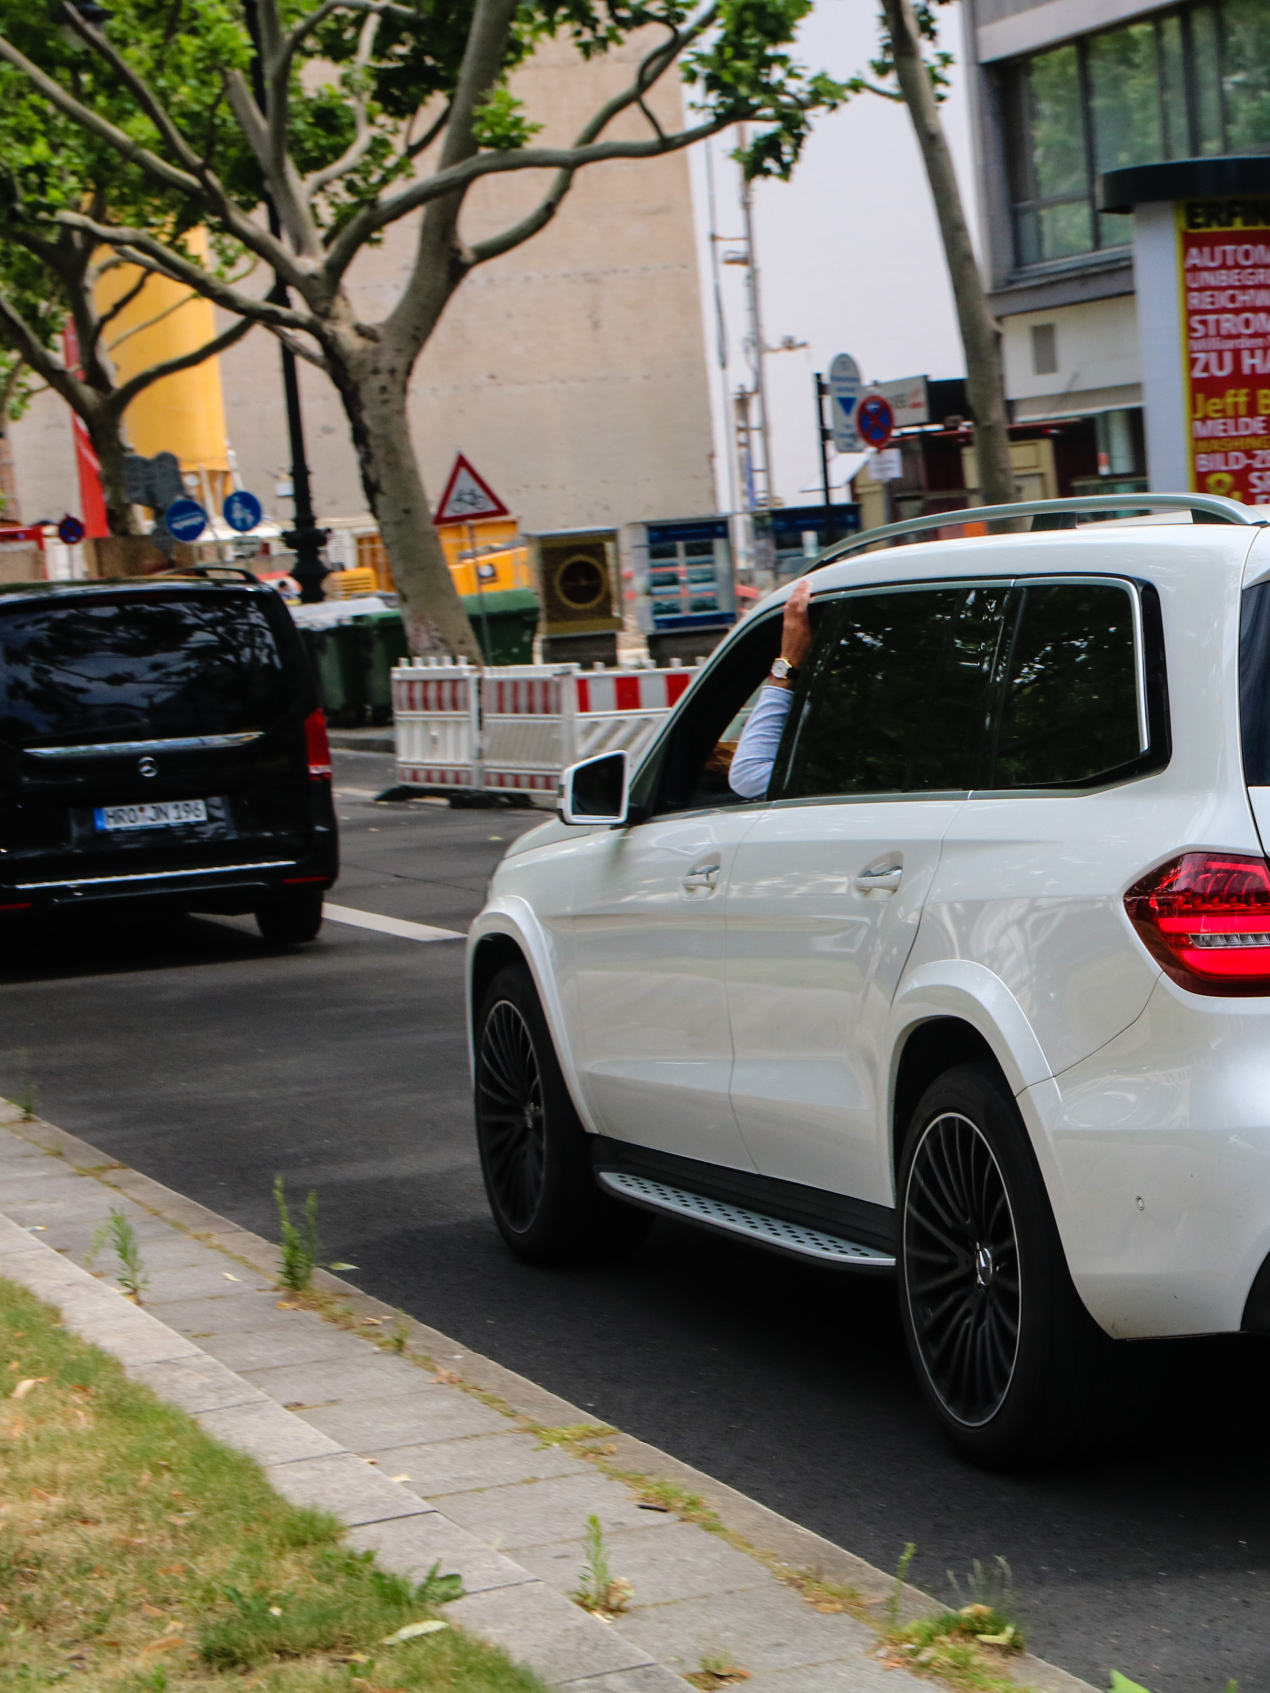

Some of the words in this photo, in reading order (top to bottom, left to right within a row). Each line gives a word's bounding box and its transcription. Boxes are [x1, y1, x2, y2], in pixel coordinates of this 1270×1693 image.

[1191, 351, 1234, 379] ZU
[1193, 388, 1250, 418] Jeff
[1193, 416, 1269, 438] MELDE
